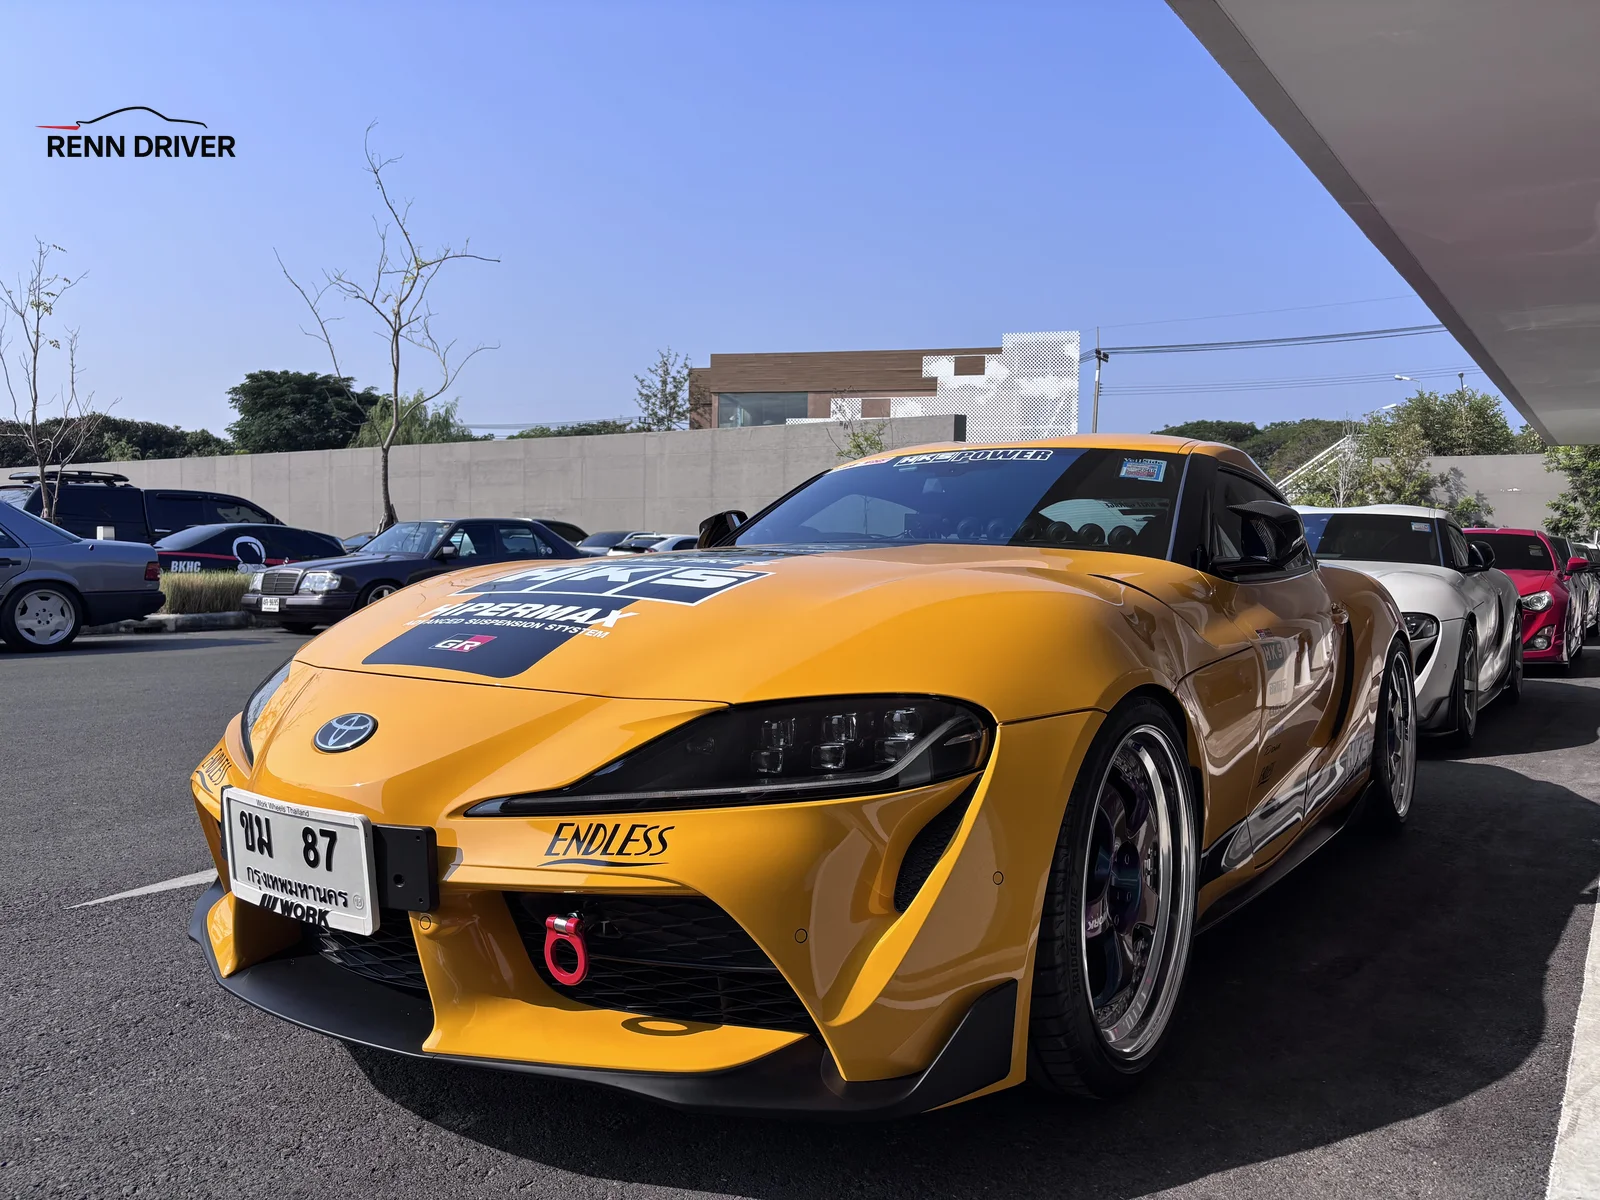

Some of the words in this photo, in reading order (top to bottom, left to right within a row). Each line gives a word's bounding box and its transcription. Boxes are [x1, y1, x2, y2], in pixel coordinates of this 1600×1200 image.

[951, 450, 1053, 462] POWER
[170, 560, 202, 573] BKHC
[418, 602, 640, 629] HIPERMAX
[403, 617, 465, 627] ADVANCED
[465, 617, 546, 630] SUSPENSION
[545, 623, 611, 639] STYSTEM
[434, 639, 482, 651] GR
[1262, 643, 1285, 661] HKS
[239, 810, 274, 859] ขม
[301, 825, 338, 872] 87
[543, 822, 676, 857] ENDLESS
[246, 865, 349, 908] กรุงเทพมหานคร
